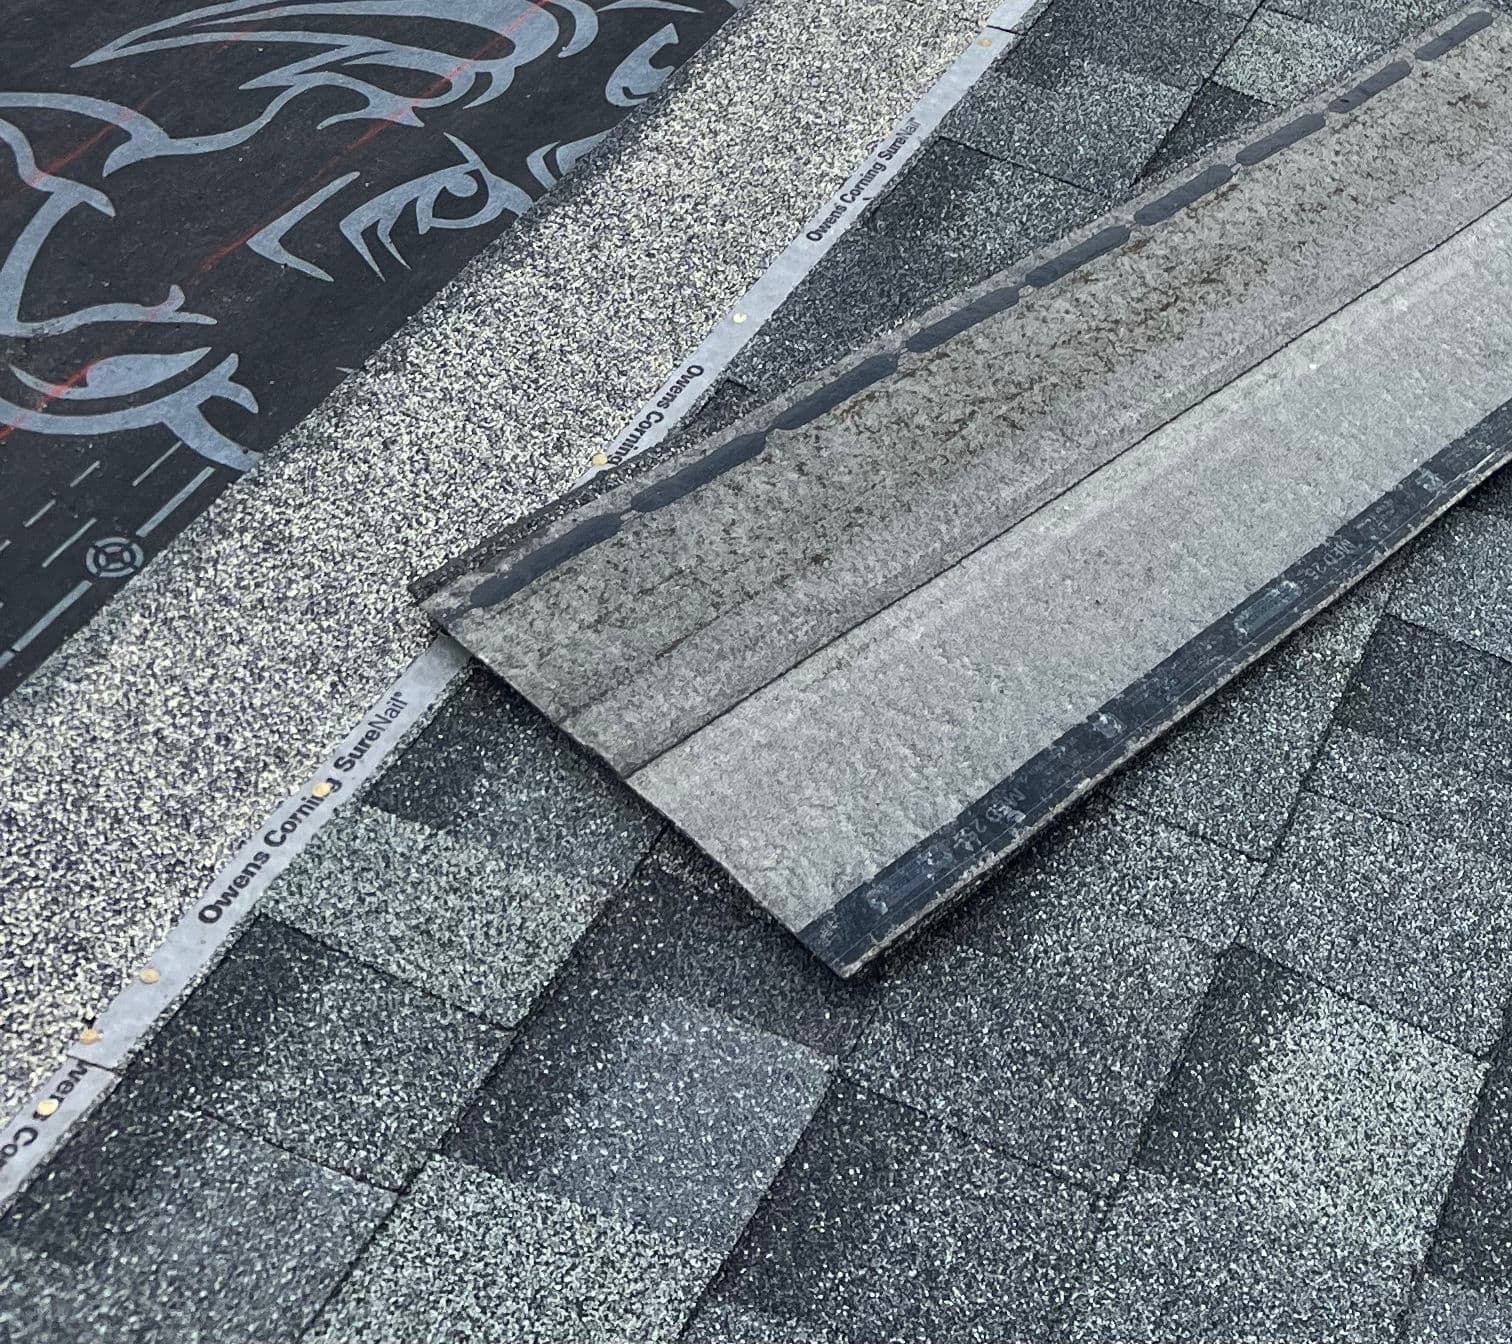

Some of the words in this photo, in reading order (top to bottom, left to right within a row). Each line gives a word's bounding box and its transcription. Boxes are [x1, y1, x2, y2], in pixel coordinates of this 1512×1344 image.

[805, 201, 849, 243] Owens
[839, 162, 888, 204] Corning
[657, 364, 705, 409] Owens
[198, 850, 270, 926] Owens
